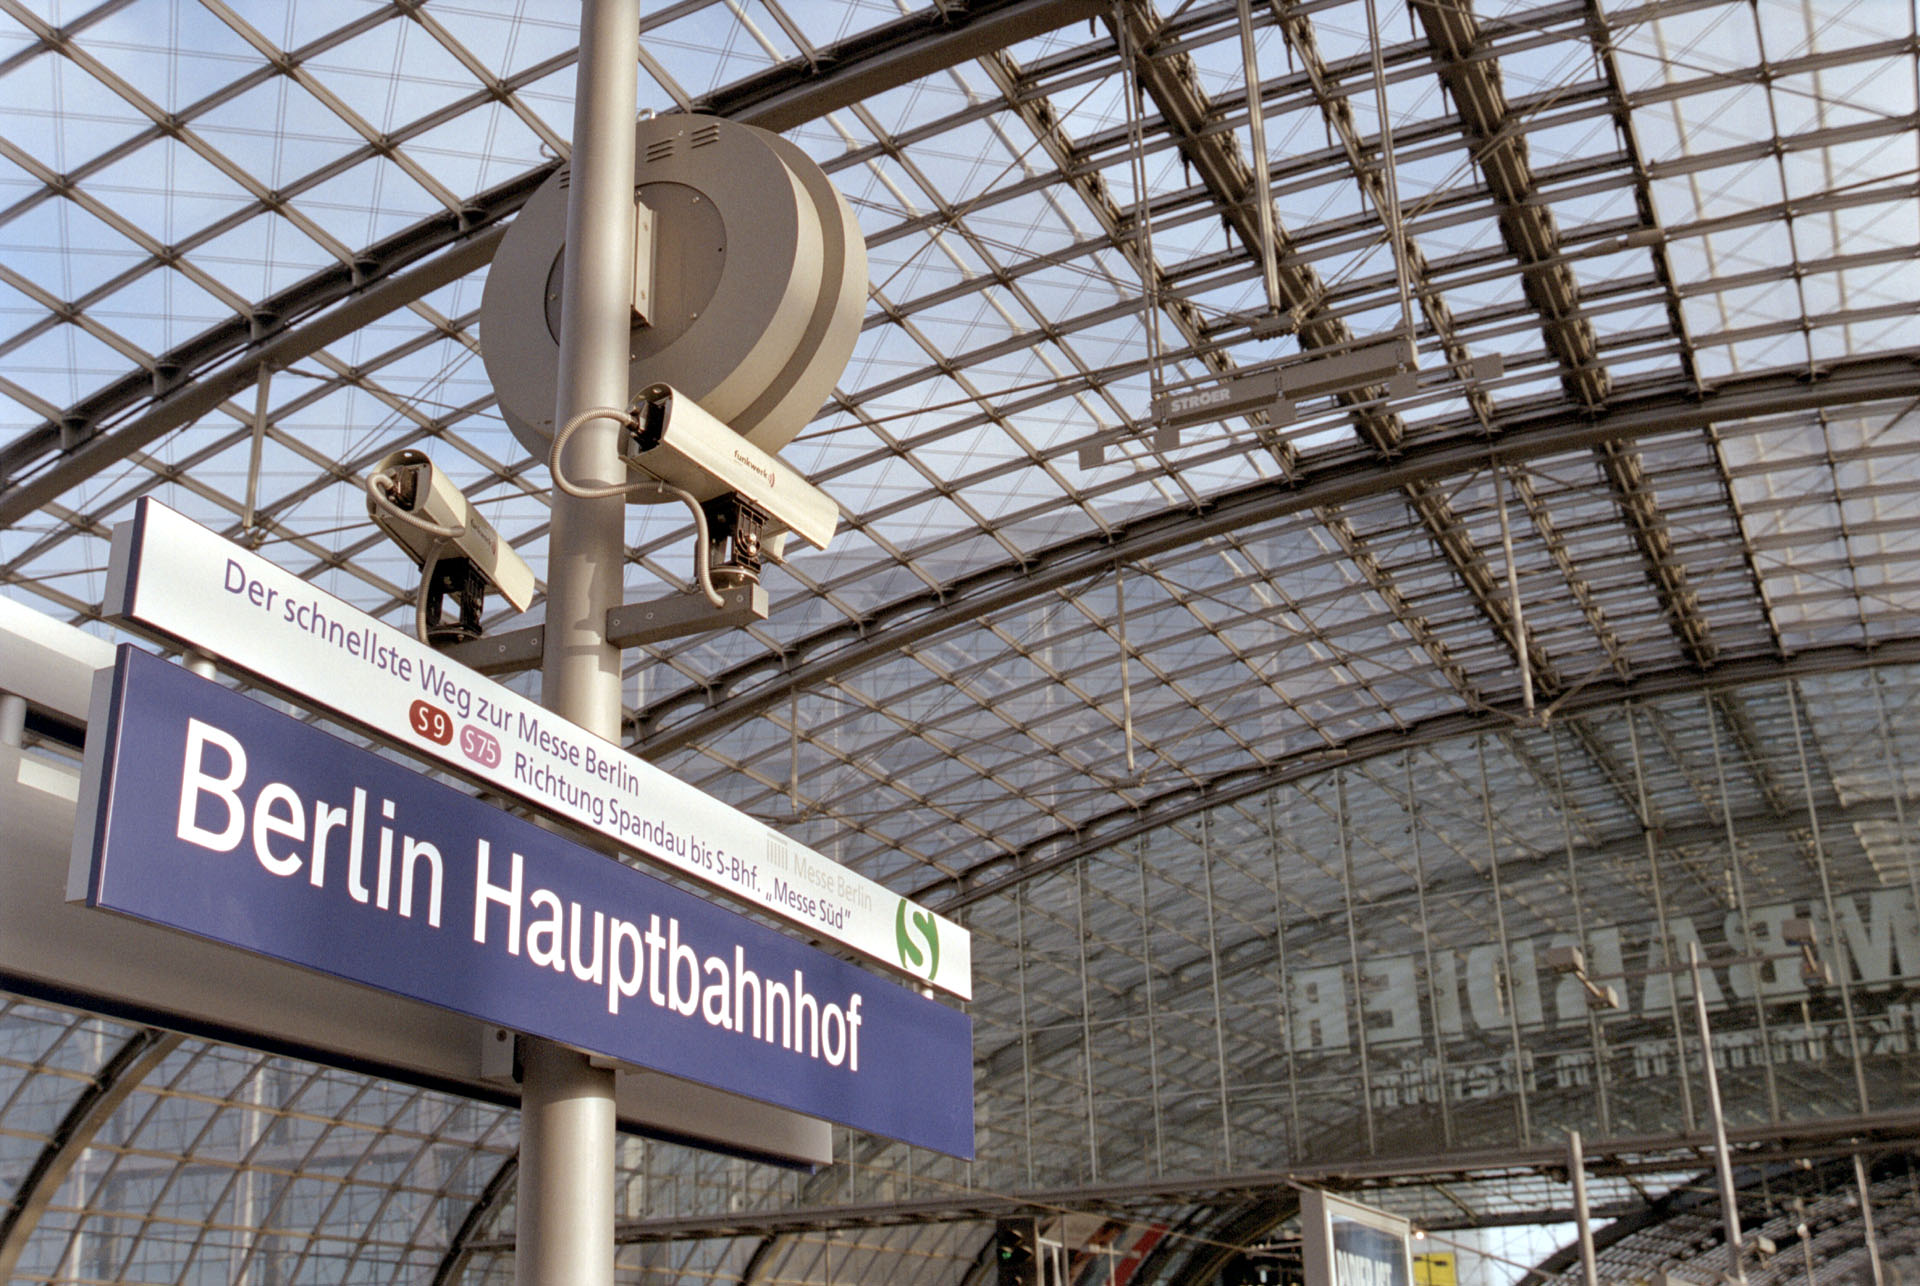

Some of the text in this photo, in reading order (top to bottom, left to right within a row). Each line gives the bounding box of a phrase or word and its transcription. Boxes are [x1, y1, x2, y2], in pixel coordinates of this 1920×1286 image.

[224, 558, 639, 796] Der schnellste Weg zur Messe Berlin
[465, 729, 496, 763] S75
[514, 752, 604, 825] Richtung
[609, 799, 686, 858] Spandau
[691, 835, 713, 870] bis
[716, 850, 760, 893] S-Bhf.
[794, 853, 872, 912] Messe Berlin
[177, 717, 862, 1072] Berlin Hauptbahnhof
